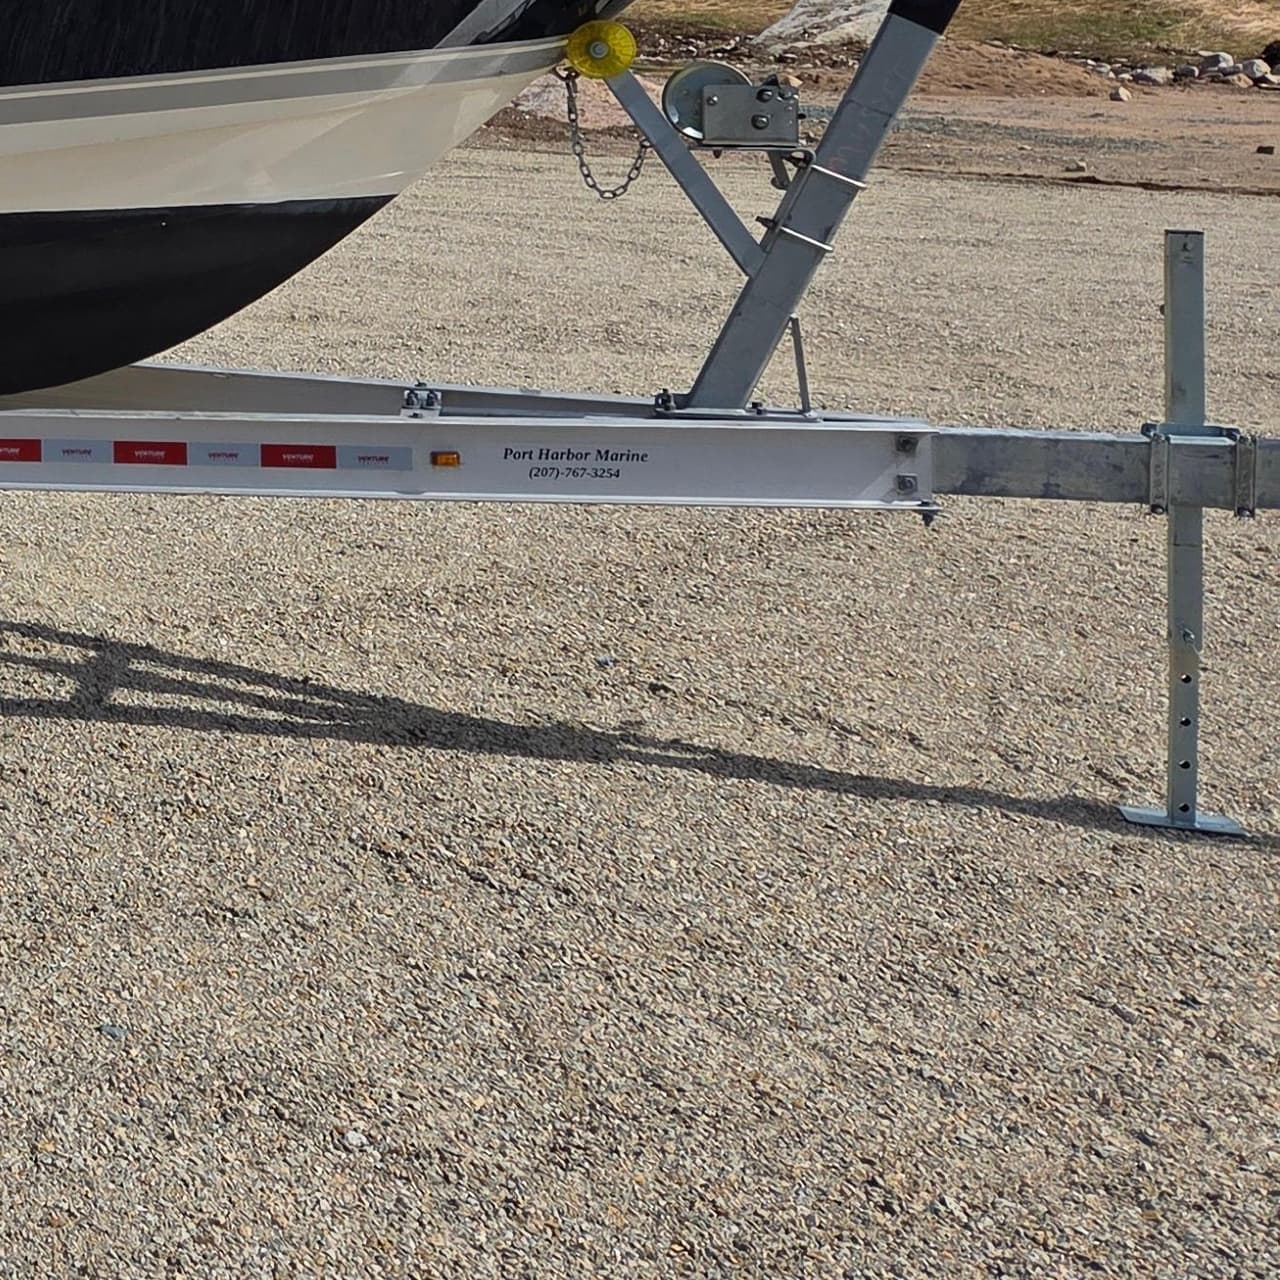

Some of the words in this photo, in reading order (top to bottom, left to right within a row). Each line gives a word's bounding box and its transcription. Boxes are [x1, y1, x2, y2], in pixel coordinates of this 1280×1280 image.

[503, 448, 533, 461] Port
[538, 448, 591, 461] Harbor
[595, 449, 648, 462] Marine
[529, 467, 620, 480] (207)-767-3254
